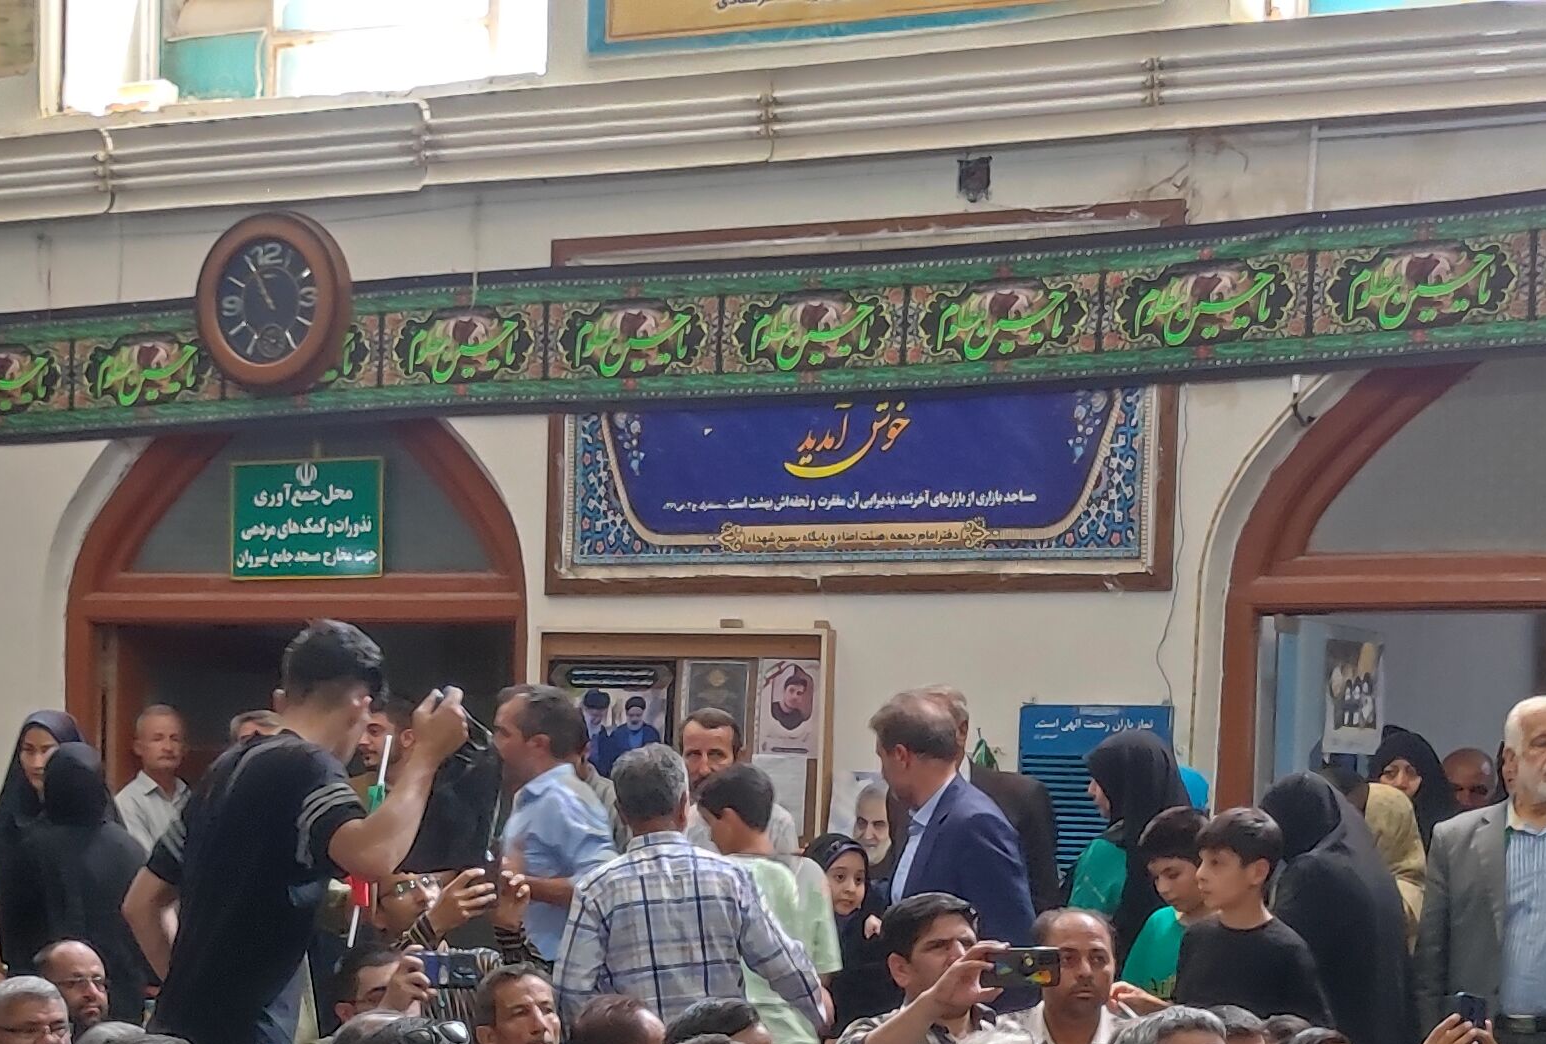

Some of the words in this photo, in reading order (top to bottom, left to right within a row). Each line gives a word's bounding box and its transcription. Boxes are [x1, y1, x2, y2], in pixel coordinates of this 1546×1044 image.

[250, 242, 284, 265] 12
[299, 286, 319, 307] 3
[1379, 251, 1495, 330] حسین
[221, 295, 241, 317] 9
[1163, 270, 1275, 346] حسین
[964, 291, 1068, 361] حسین
[599, 313, 691, 378] حسین
[776, 303, 876, 371] حسین
[431, 319, 518, 384] حسین
[784, 401, 911, 479] خوش
[797, 402, 853, 466] آمدید
[321, 483, 354, 506] محل
[846, 491, 860, 510] آن
[929, 490, 966, 509] بازارهای
[965, 490, 976, 508] از
[975, 489, 1005, 508] بازاری
[1004, 489, 1038, 507] مساجد
[240, 522, 277, 541] مردمی
[326, 522, 334, 538] و
[332, 514, 373, 538] نذورات
[918, 530, 939, 545] امام
[938, 530, 960, 545] دفتر
[236, 547, 270, 569] شیروان
[269, 547, 294, 568] جامع
[293, 549, 321, 567] مسجد
[322, 546, 353, 567] مخارج
[353, 549, 378, 565] جهت
[1060, 717, 1082, 732] الهی
[1083, 719, 1110, 733] رحمت
